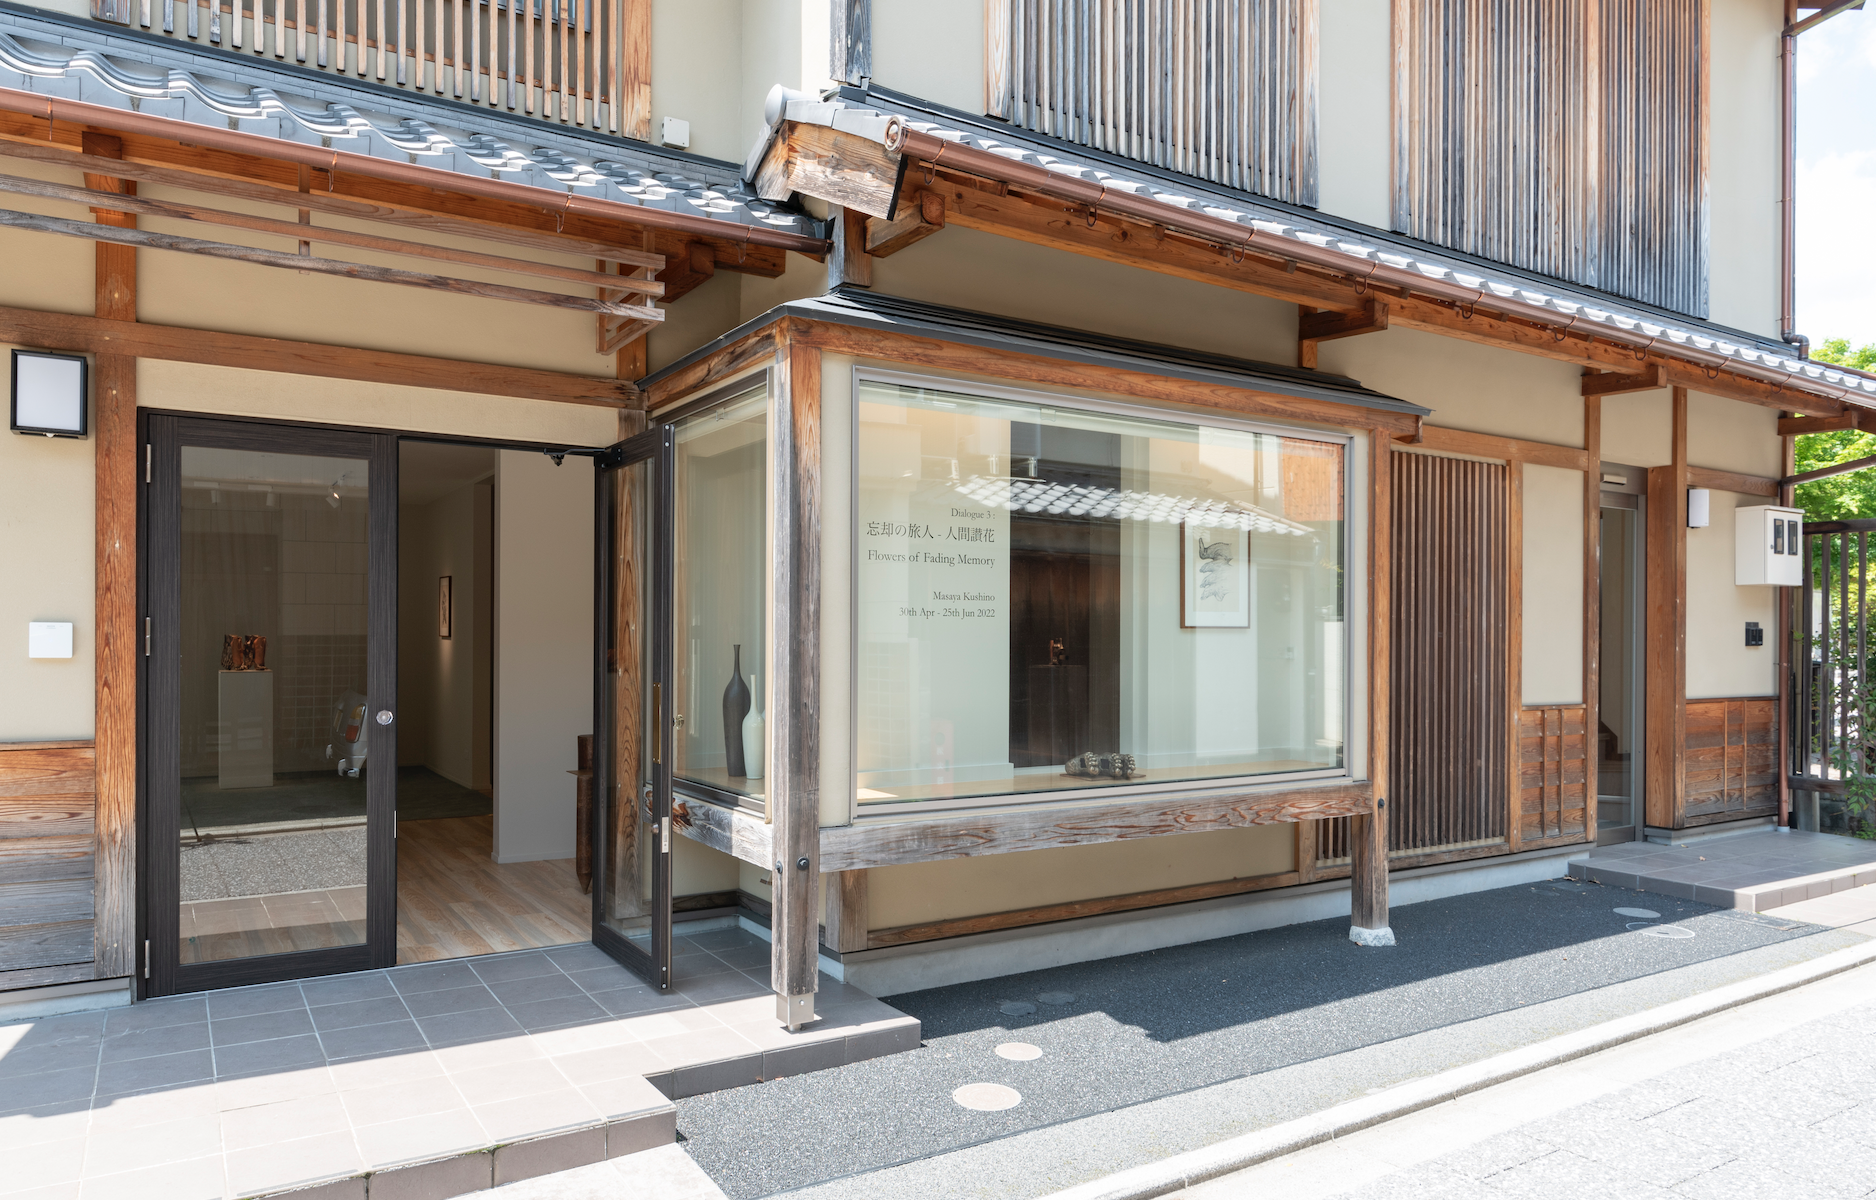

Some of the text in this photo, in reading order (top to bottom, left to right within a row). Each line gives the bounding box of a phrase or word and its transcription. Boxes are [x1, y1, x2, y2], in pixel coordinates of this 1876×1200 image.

[951, 508, 984, 520] Dialogue
[867, 521, 934, 538] 忘却の旅人
[868, 550, 996, 568] Flowers of Fading Memory
[933, 591, 996, 603] Masaya Kushino
[899, 607, 917, 617] 30th
[919, 608, 935, 620] Apr
[942, 608, 960, 617] 25th
[961, 608, 975, 620] Jun
[977, 608, 996, 618] 2022
